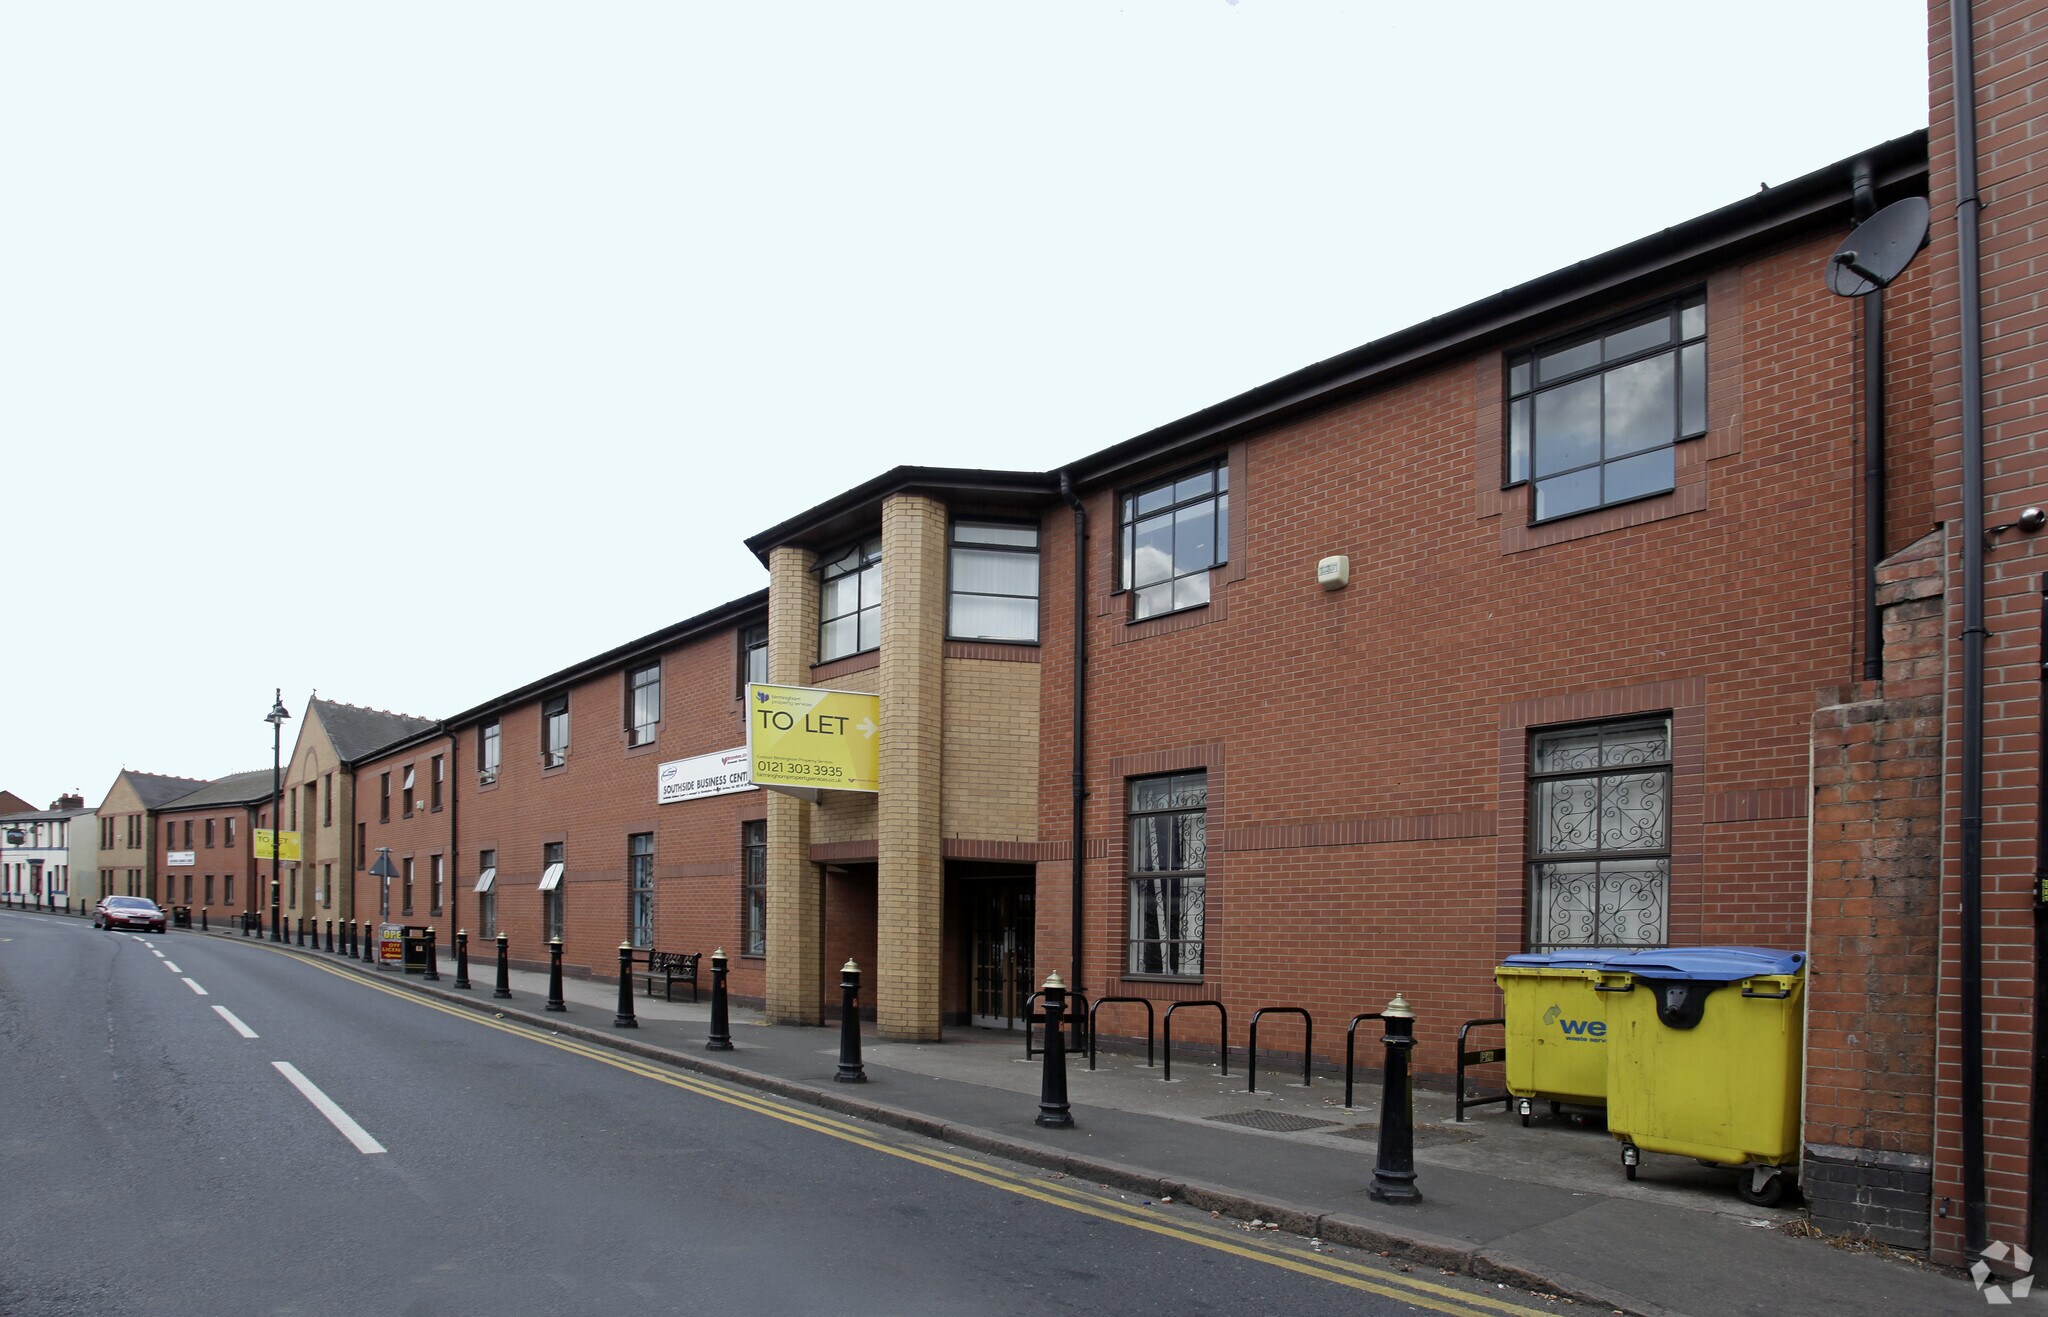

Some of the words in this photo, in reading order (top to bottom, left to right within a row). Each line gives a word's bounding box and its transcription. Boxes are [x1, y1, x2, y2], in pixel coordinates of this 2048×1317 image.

[771, 694, 801, 702] birmingham
[757, 709, 794, 731] TO
[805, 713, 850, 735] LET
[757, 760, 783, 773] 0121
[787, 763, 811, 775] 303
[813, 765, 843, 777] 3935
[663, 781, 695, 795] SOUTHSIDE
[696, 774, 727, 789] BUSINESS
[729, 771, 748, 784] CENT
